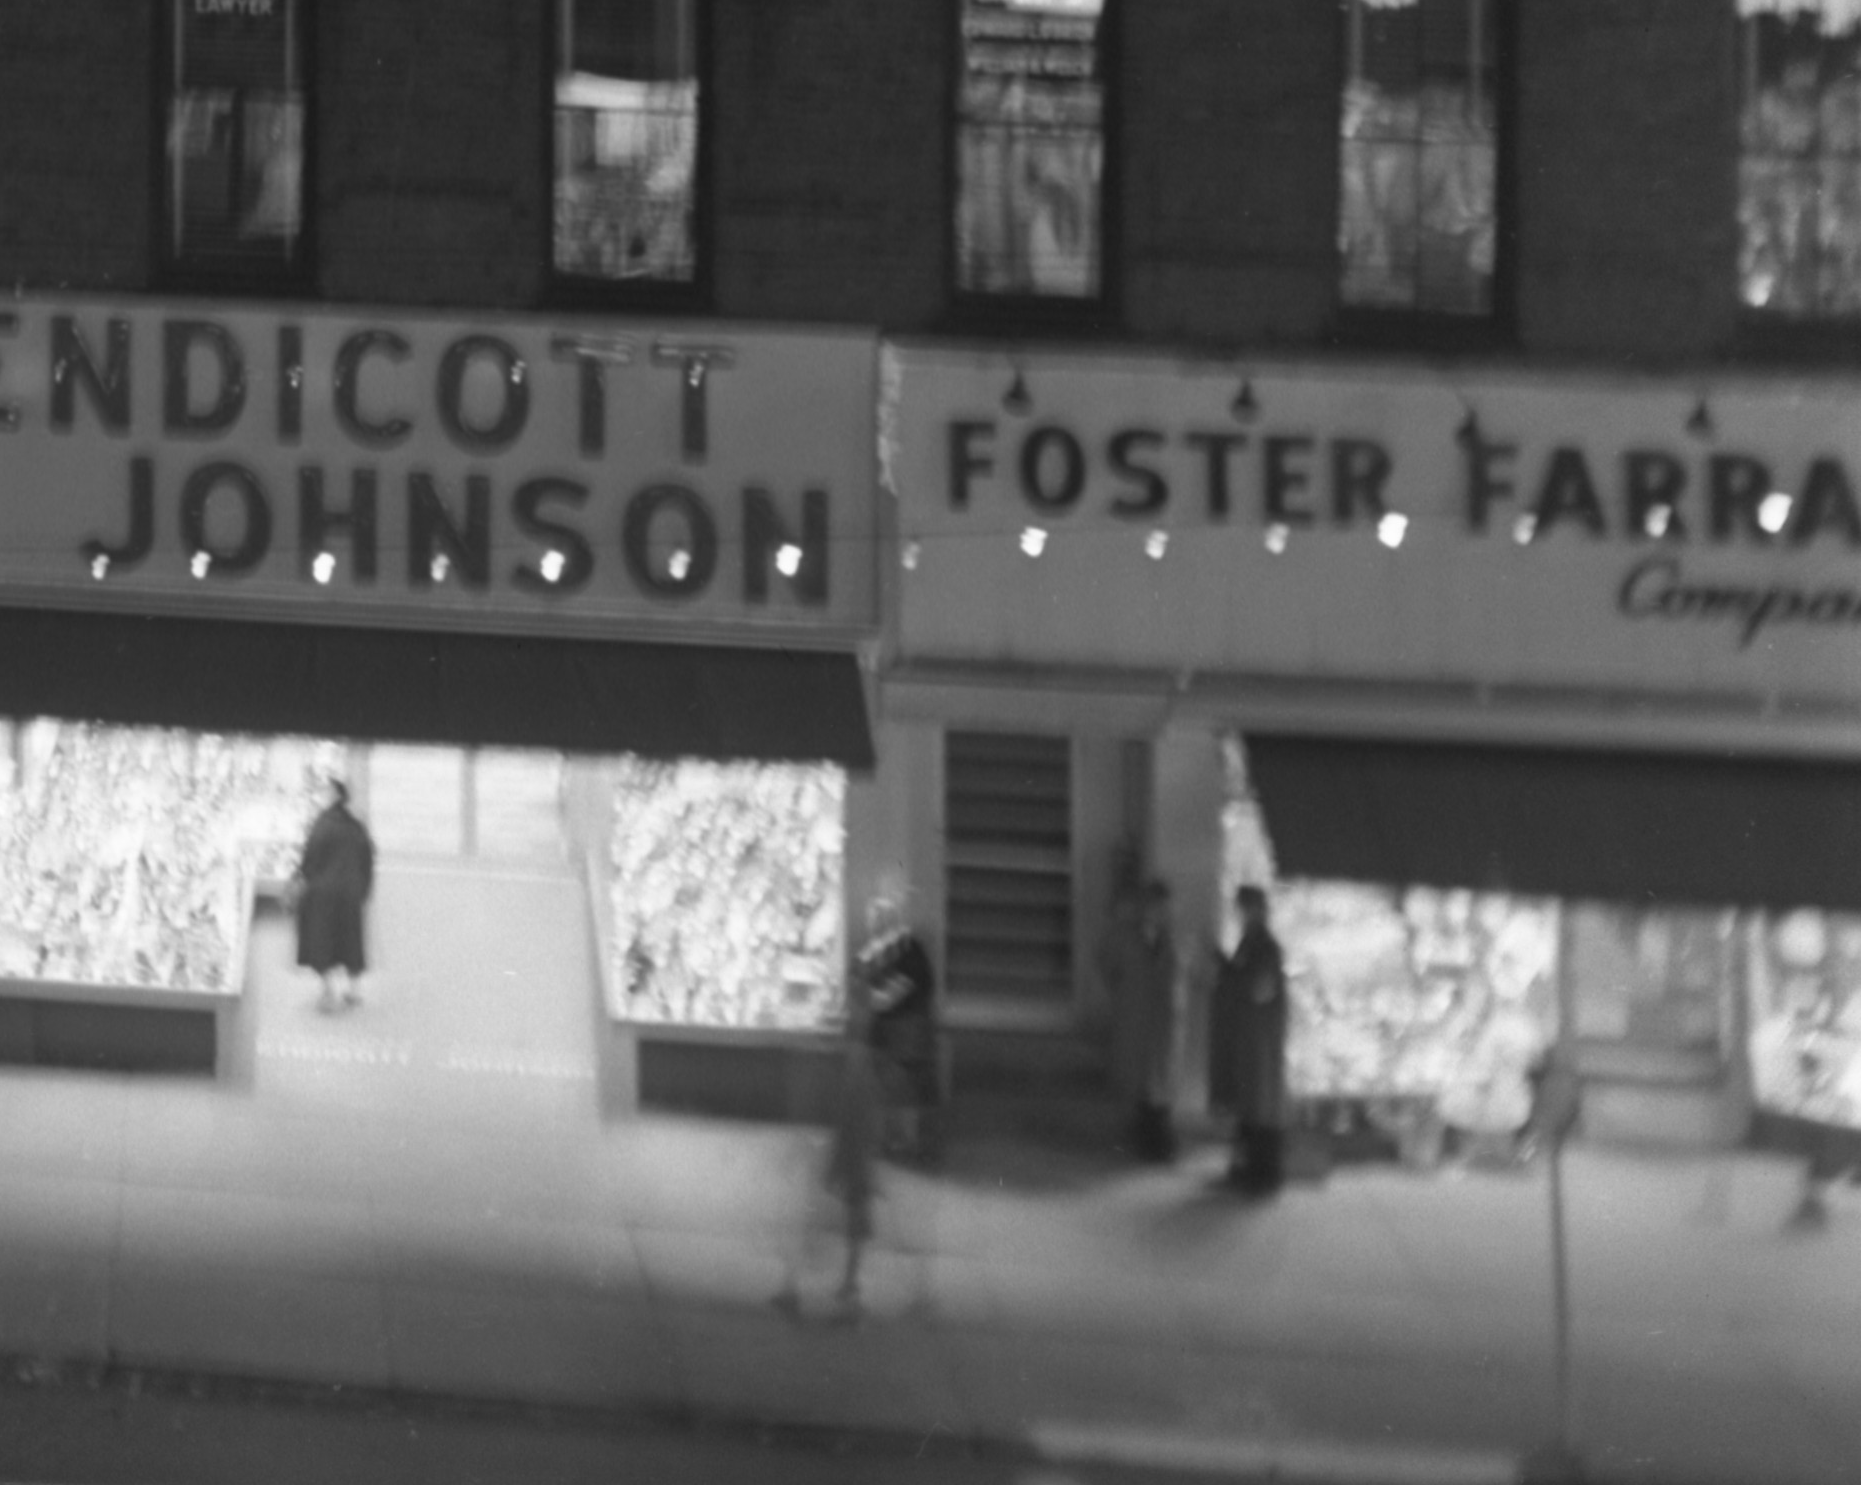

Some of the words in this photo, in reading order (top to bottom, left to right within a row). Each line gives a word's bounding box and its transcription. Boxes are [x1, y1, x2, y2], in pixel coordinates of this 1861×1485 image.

[946, 420, 1396, 525] FOSTER
[81, 456, 830, 607] JOHNSON
[1616, 553, 1861, 649] Compa
